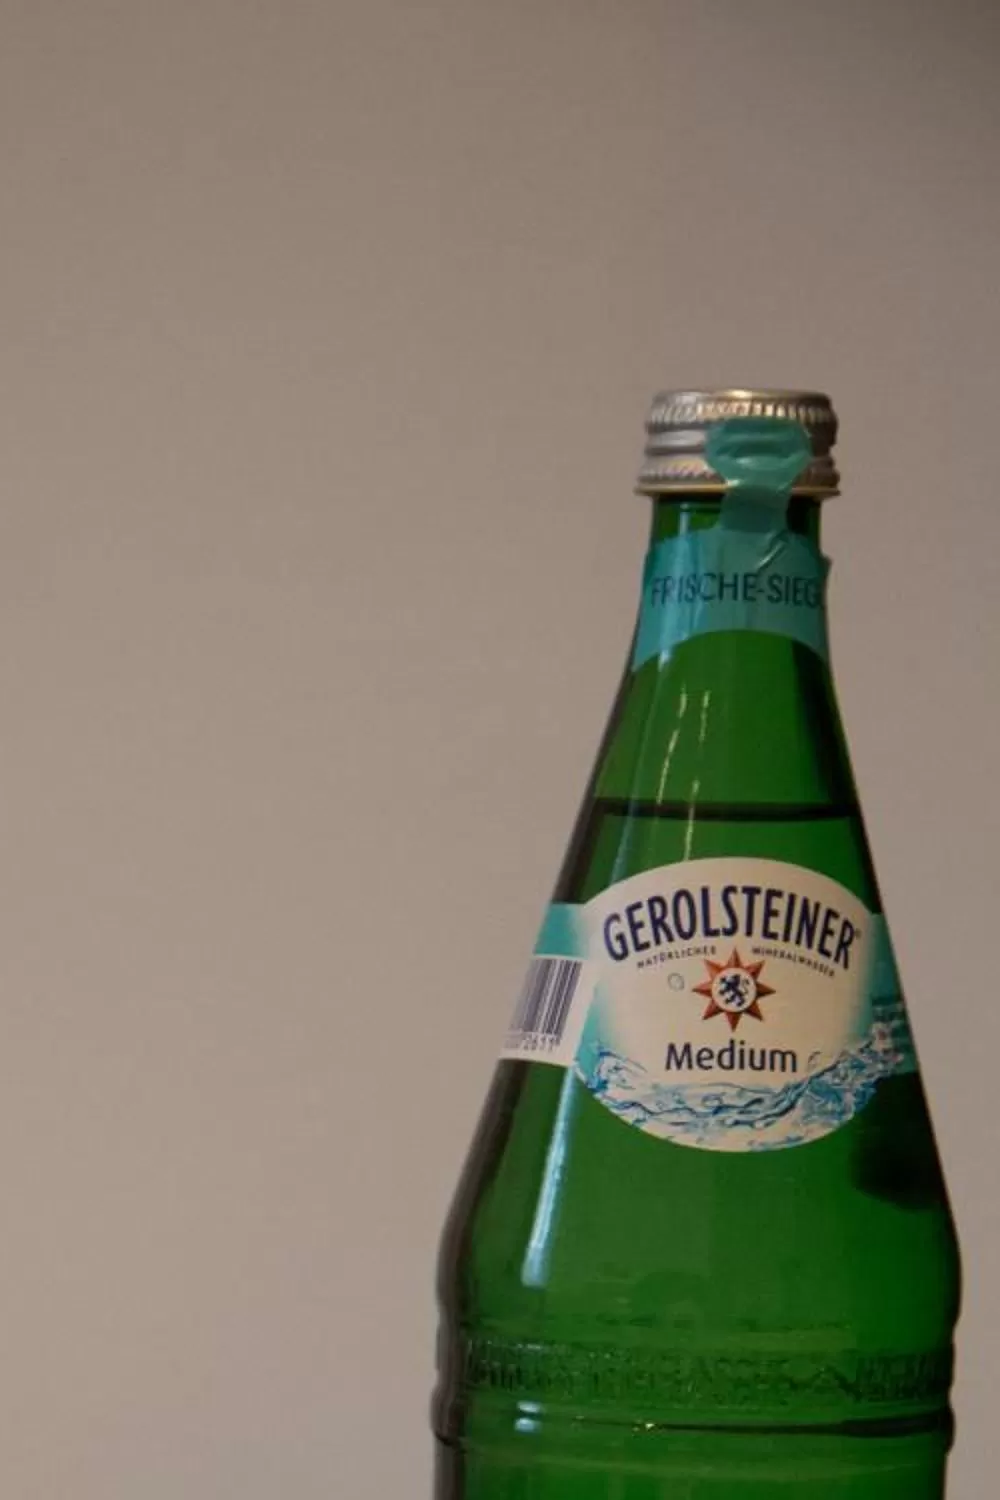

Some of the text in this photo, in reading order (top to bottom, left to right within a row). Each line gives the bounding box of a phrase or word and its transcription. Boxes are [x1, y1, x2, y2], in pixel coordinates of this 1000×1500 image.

[650, 572, 826, 610] FRISCHE-SIEG
[603, 886, 857, 971] GEROLSTEINER
[665, 1038, 797, 1074] Medium
